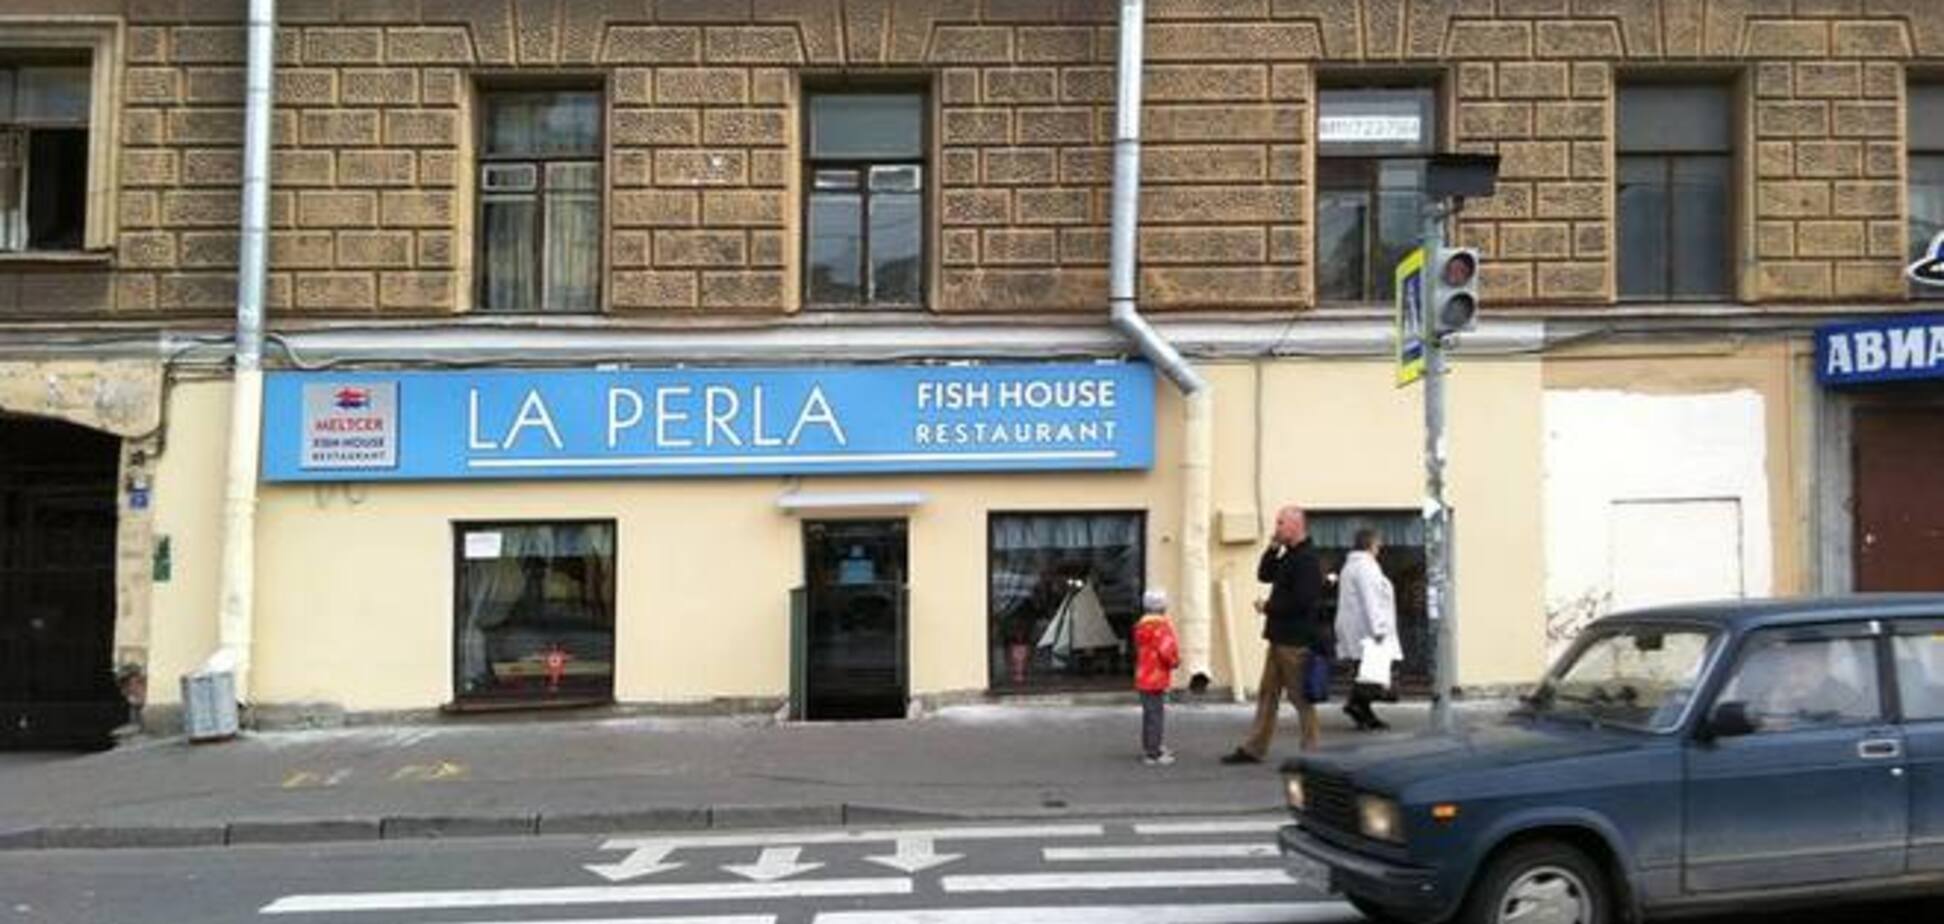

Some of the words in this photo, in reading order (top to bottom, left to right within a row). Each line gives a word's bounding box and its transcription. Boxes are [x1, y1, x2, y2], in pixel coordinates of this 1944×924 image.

[917, 382, 989, 409] FISH
[1000, 380, 1117, 408] HOUSE
[469, 388, 564, 449] LA
[608, 385, 848, 448] PERLA
[343, 437, 385, 449] HOUSE
[915, 421, 1117, 444] RESTAURANT
[312, 450, 387, 461] RESTAURANT
